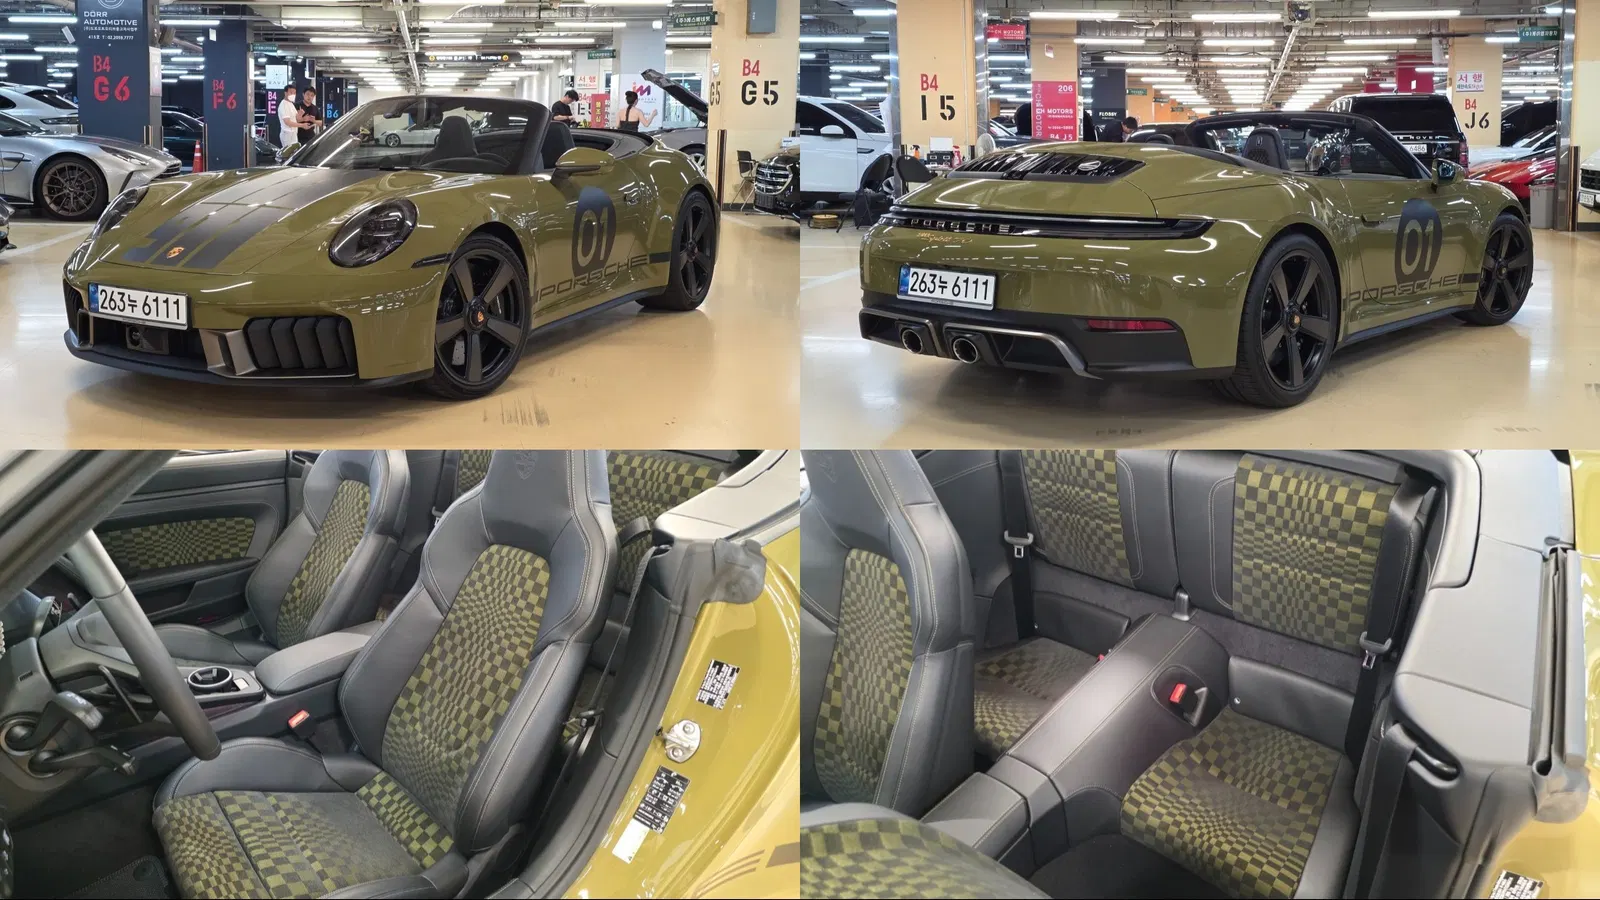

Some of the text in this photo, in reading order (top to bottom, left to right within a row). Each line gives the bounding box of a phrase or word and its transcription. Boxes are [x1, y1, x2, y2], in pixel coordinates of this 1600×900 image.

[93, 55, 111, 73] B4
[742, 59, 760, 77] B4
[212, 79, 224, 91] B4
[920, 73, 939, 91] B4
[1057, 84, 1074, 92] 206
[267, 91, 277, 100] B4
[1464, 98, 1477, 110] B4
[326, 109, 339, 118] B6
[910, 218, 1010, 233] PORSCHE
[576, 206, 609, 268] 01
[1400, 218, 1435, 276] 01
[538, 254, 648, 301] PORSCHE
[909, 271, 989, 300] 263누 6111
[1349, 273, 1459, 303] PORSCHE
[99, 288, 181, 320] 263누 6111
